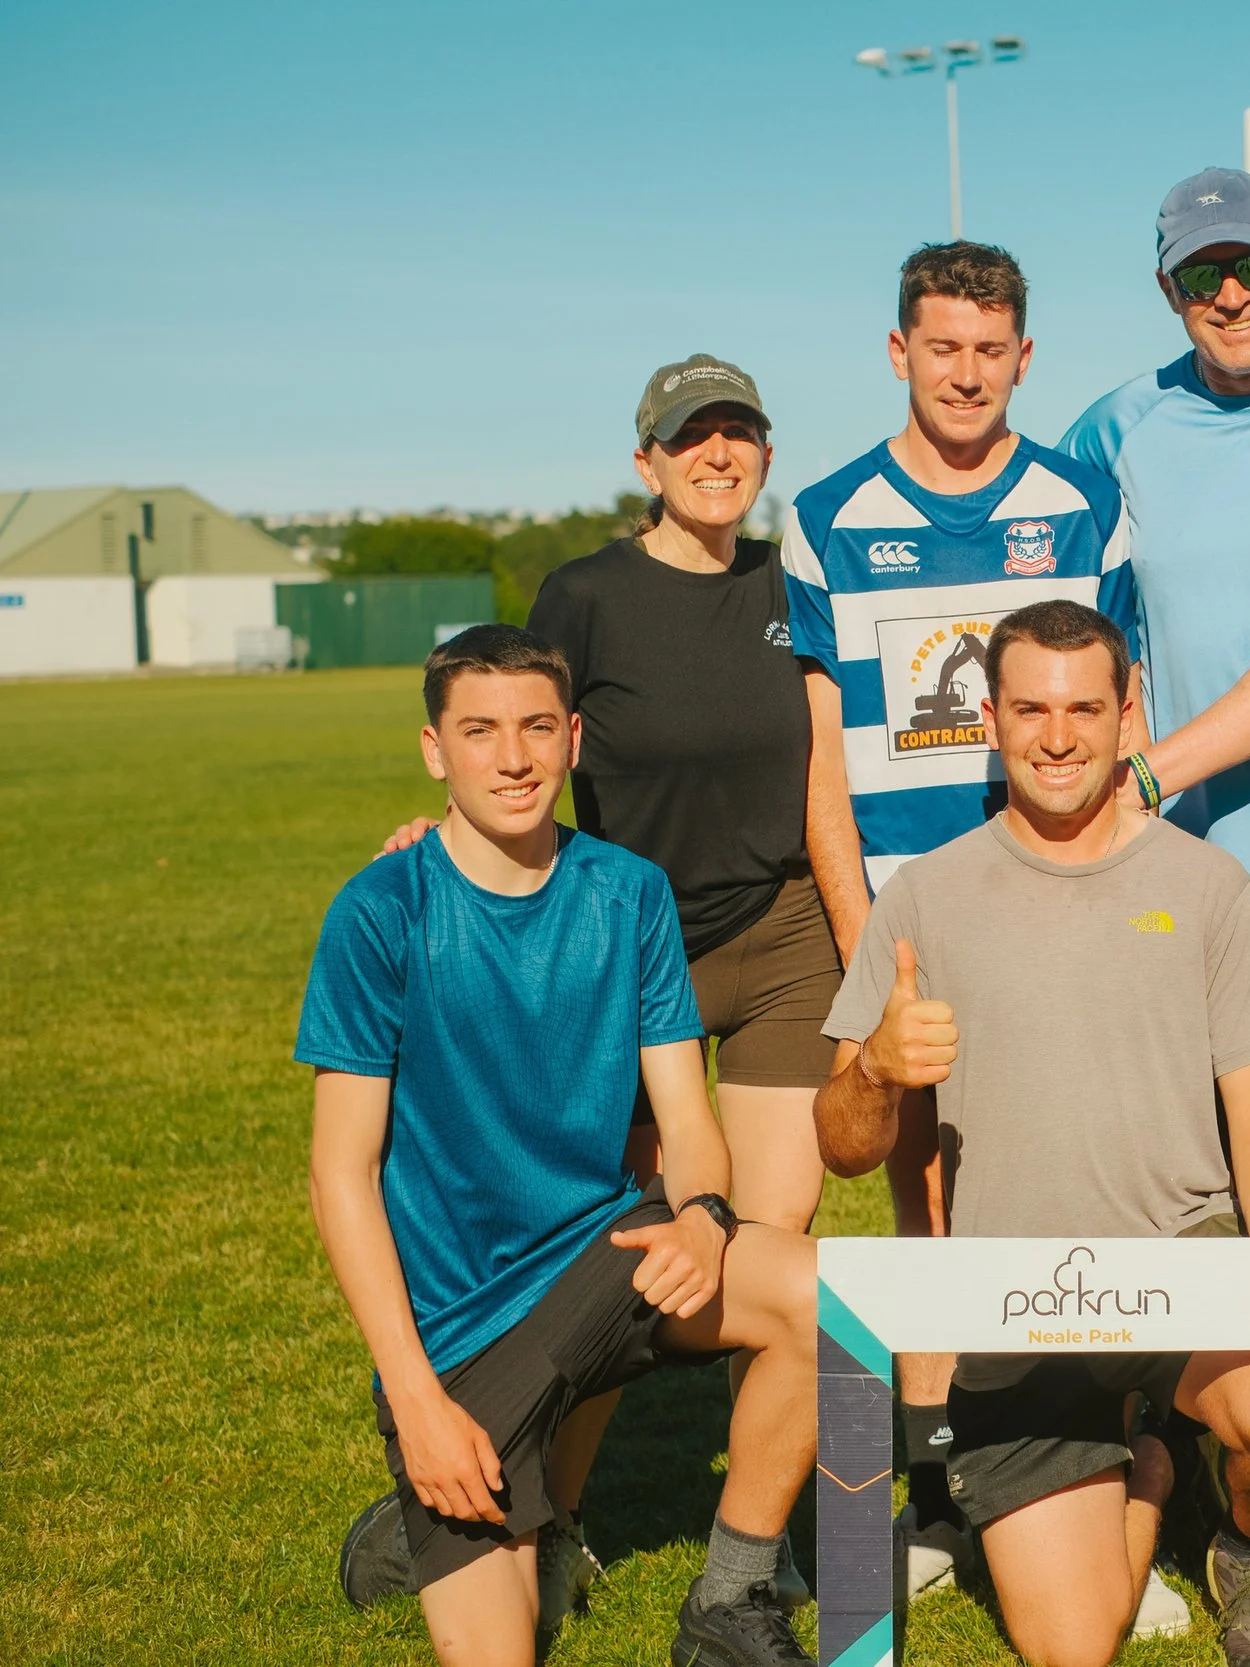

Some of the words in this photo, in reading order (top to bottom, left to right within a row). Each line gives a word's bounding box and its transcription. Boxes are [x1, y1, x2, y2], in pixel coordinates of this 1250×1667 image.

[871, 565, 920, 573] canterbury
[911, 630, 947, 672] PETE
[1002, 1246, 1171, 1325] parkrun
[1028, 1328, 1083, 1344] Neale
[1089, 1328, 1133, 1344] Park
